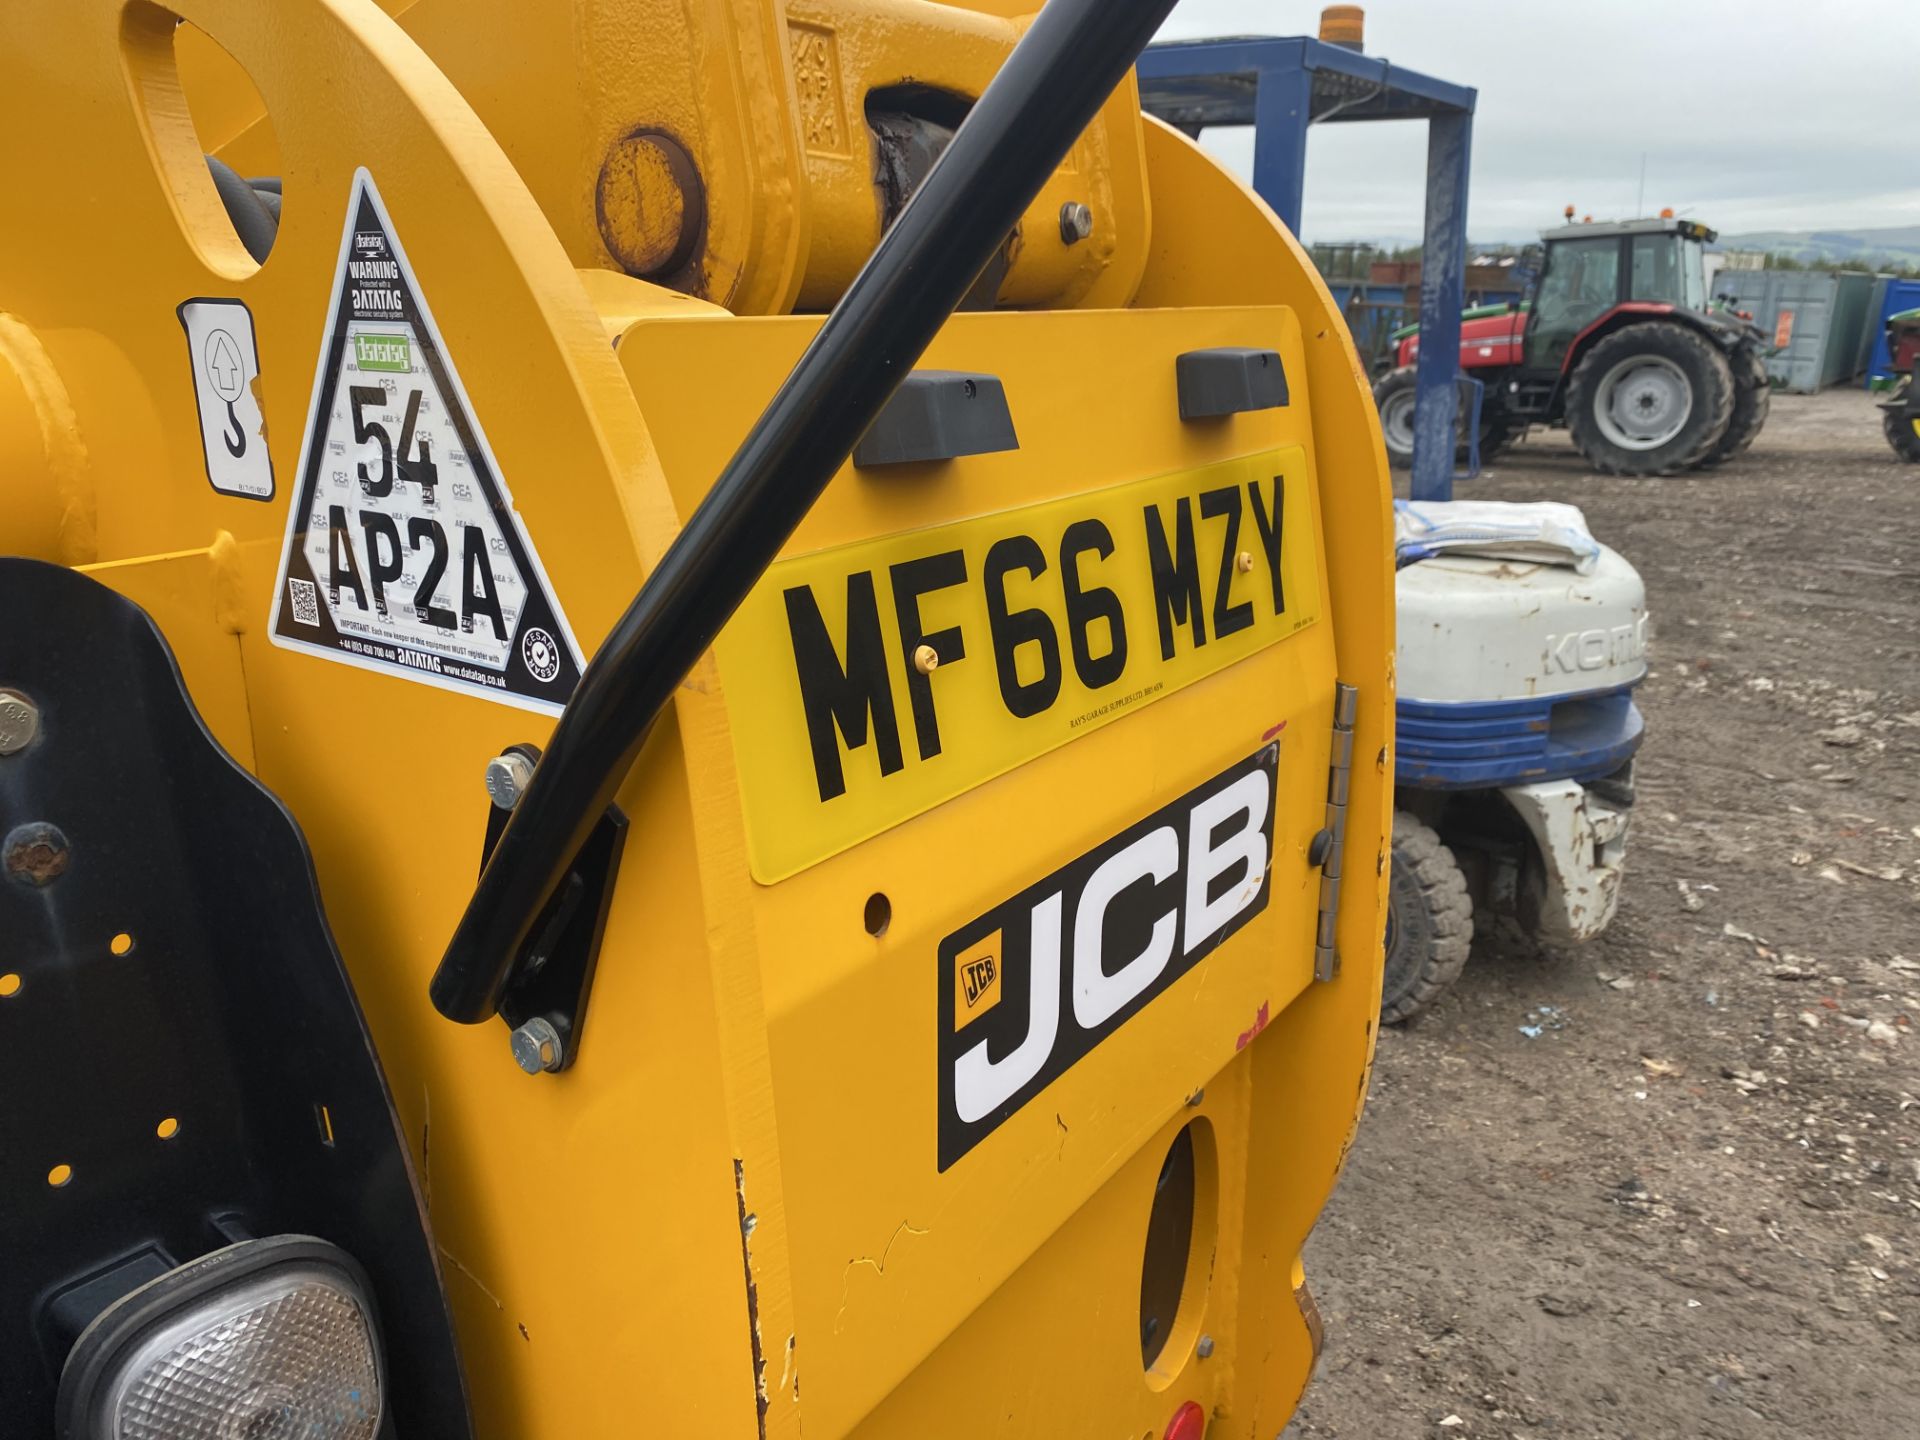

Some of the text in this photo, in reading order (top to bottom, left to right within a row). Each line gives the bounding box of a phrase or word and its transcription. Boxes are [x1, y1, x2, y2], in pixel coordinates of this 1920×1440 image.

[349, 261, 398, 279] WARNING
[352, 289, 403, 310] DATATAG
[373, 311, 388, 319] security
[389, 312, 404, 320] system
[358, 337, 409, 369] datatag
[349, 385, 438, 504] 54
[329, 504, 508, 642] AP2A
[372, 626, 382, 636] Each
[384, 631, 393, 639] new
[394, 632, 410, 643] keeper
[416, 637, 425, 646] this
[426, 639, 451, 652] equipment
[452, 645, 467, 656] MUST
[468, 649, 488, 660] register
[489, 654, 500, 663] with
[526, 632, 553, 651] CESAR
[783, 475, 1286, 803] MF66 MZY
[339, 639, 351, 650] +44
[397, 647, 442, 673] DATATAG
[443, 664, 507, 689] www.datatag.co.uk
[529, 658, 556, 678] CESAR
[1069, 713, 1086, 729] RAY'S
[1086, 704, 1109, 721] GARAGE
[1109, 694, 1133, 712] SUPPLIES
[954, 769, 1270, 1124] JCB
[967, 957, 995, 1002] JCB
